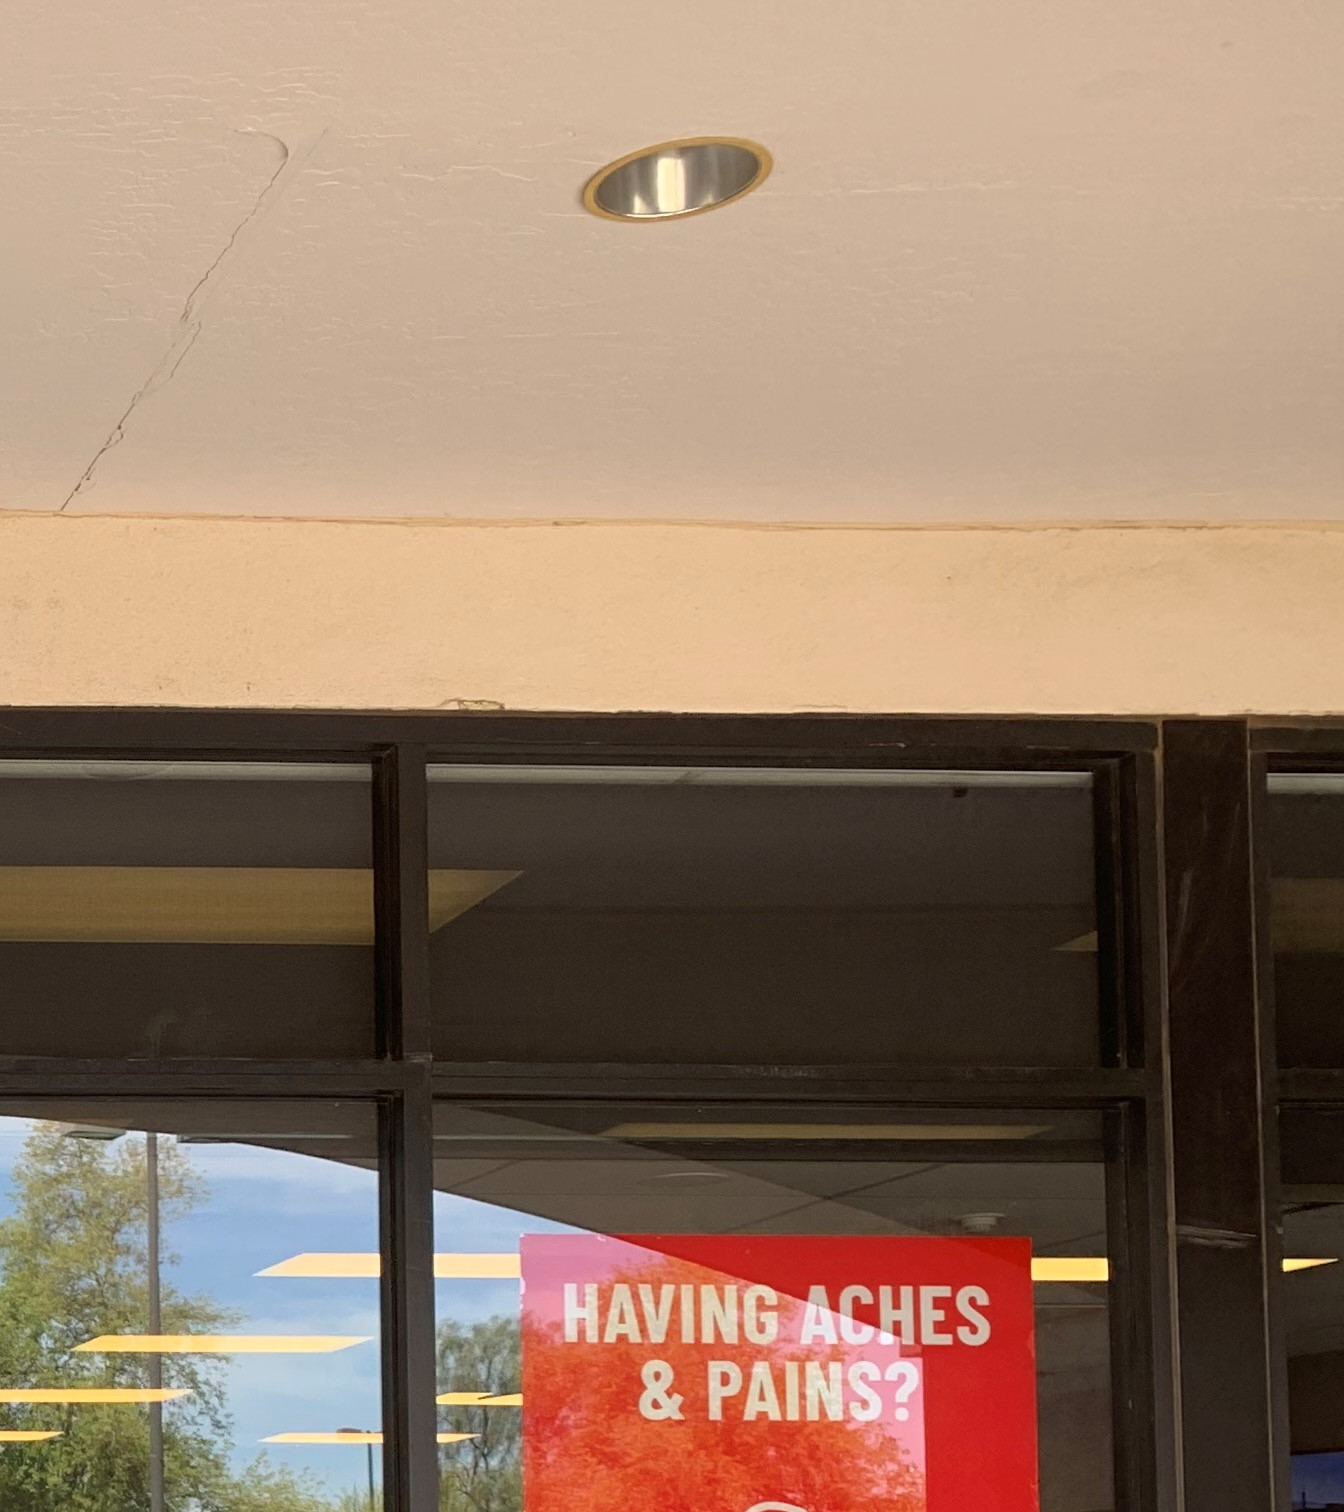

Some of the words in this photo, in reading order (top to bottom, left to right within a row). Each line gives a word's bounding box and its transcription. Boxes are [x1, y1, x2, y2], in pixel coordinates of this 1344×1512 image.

[563, 1282, 780, 1345] HAVING
[802, 1284, 992, 1348] ACHES
[638, 1359, 684, 1422] &
[708, 1359, 921, 1422] PAINS?
